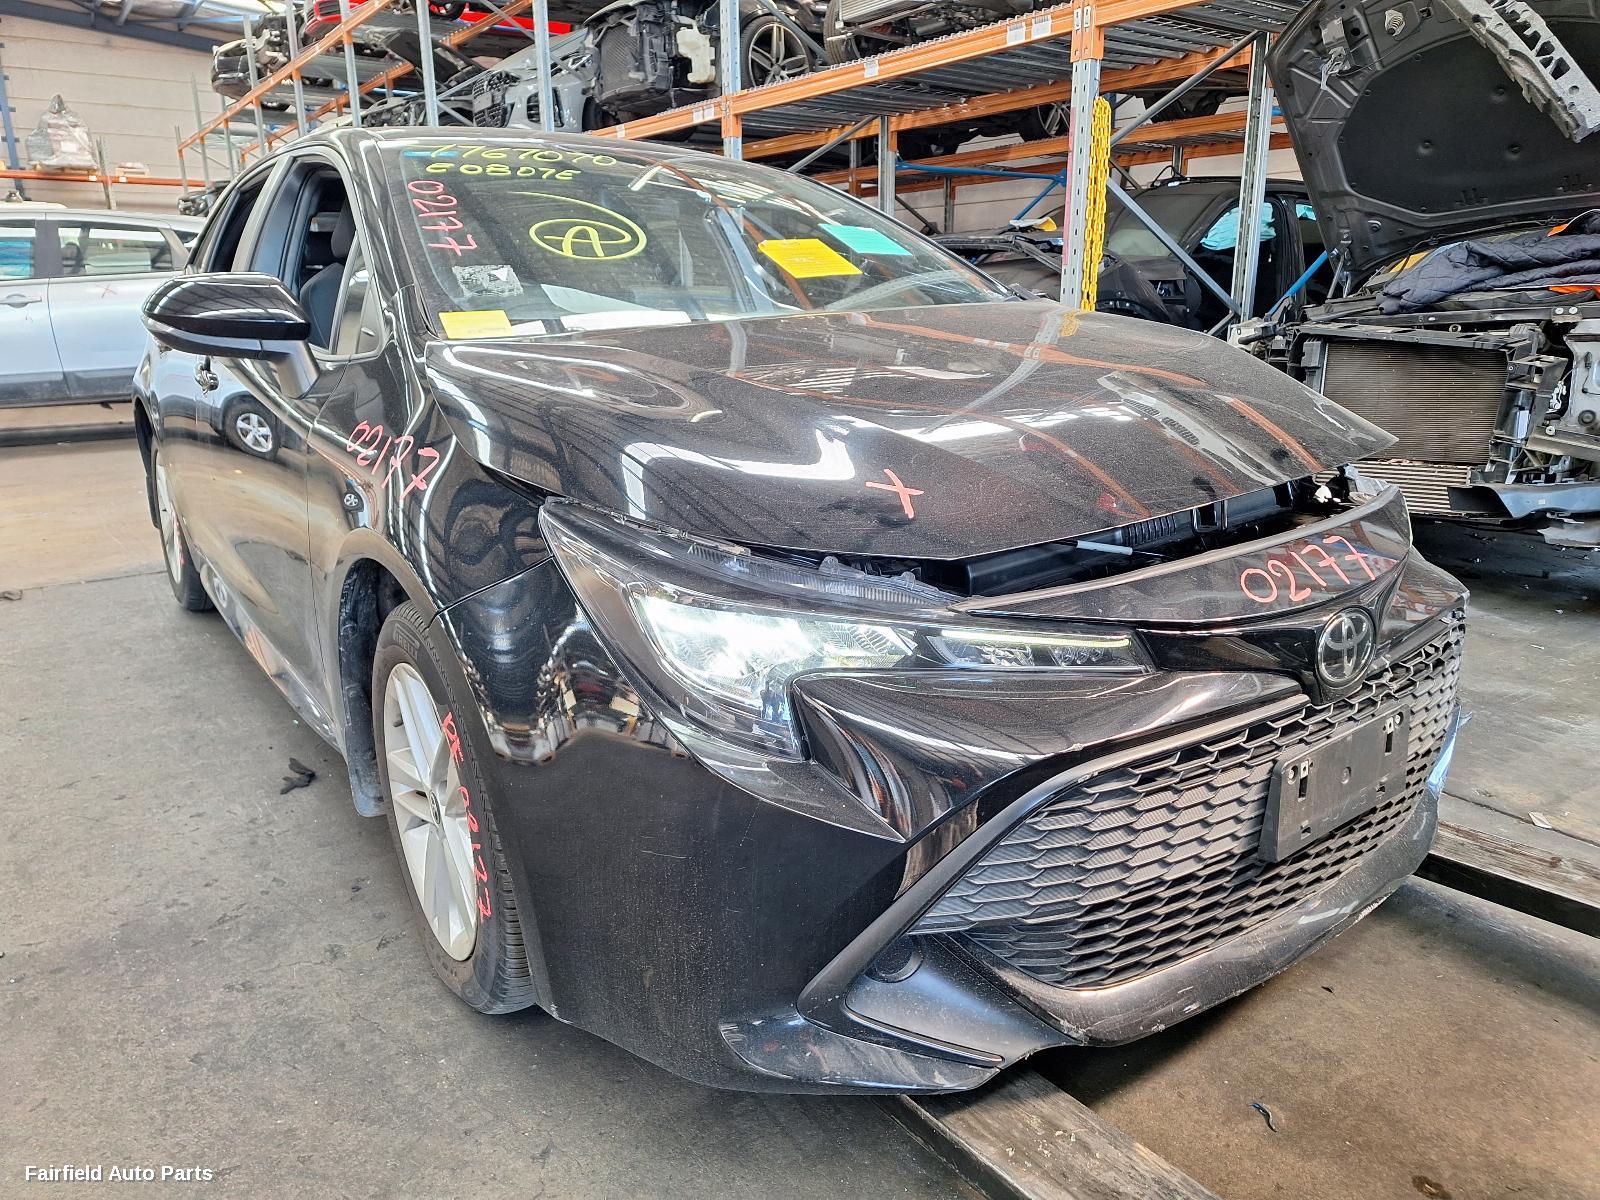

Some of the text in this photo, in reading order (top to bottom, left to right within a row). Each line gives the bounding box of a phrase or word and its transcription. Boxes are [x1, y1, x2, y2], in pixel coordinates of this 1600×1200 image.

[407, 180, 478, 257] 02177
[346, 419, 440, 501] 02177
[1240, 535, 1377, 603] 02177
